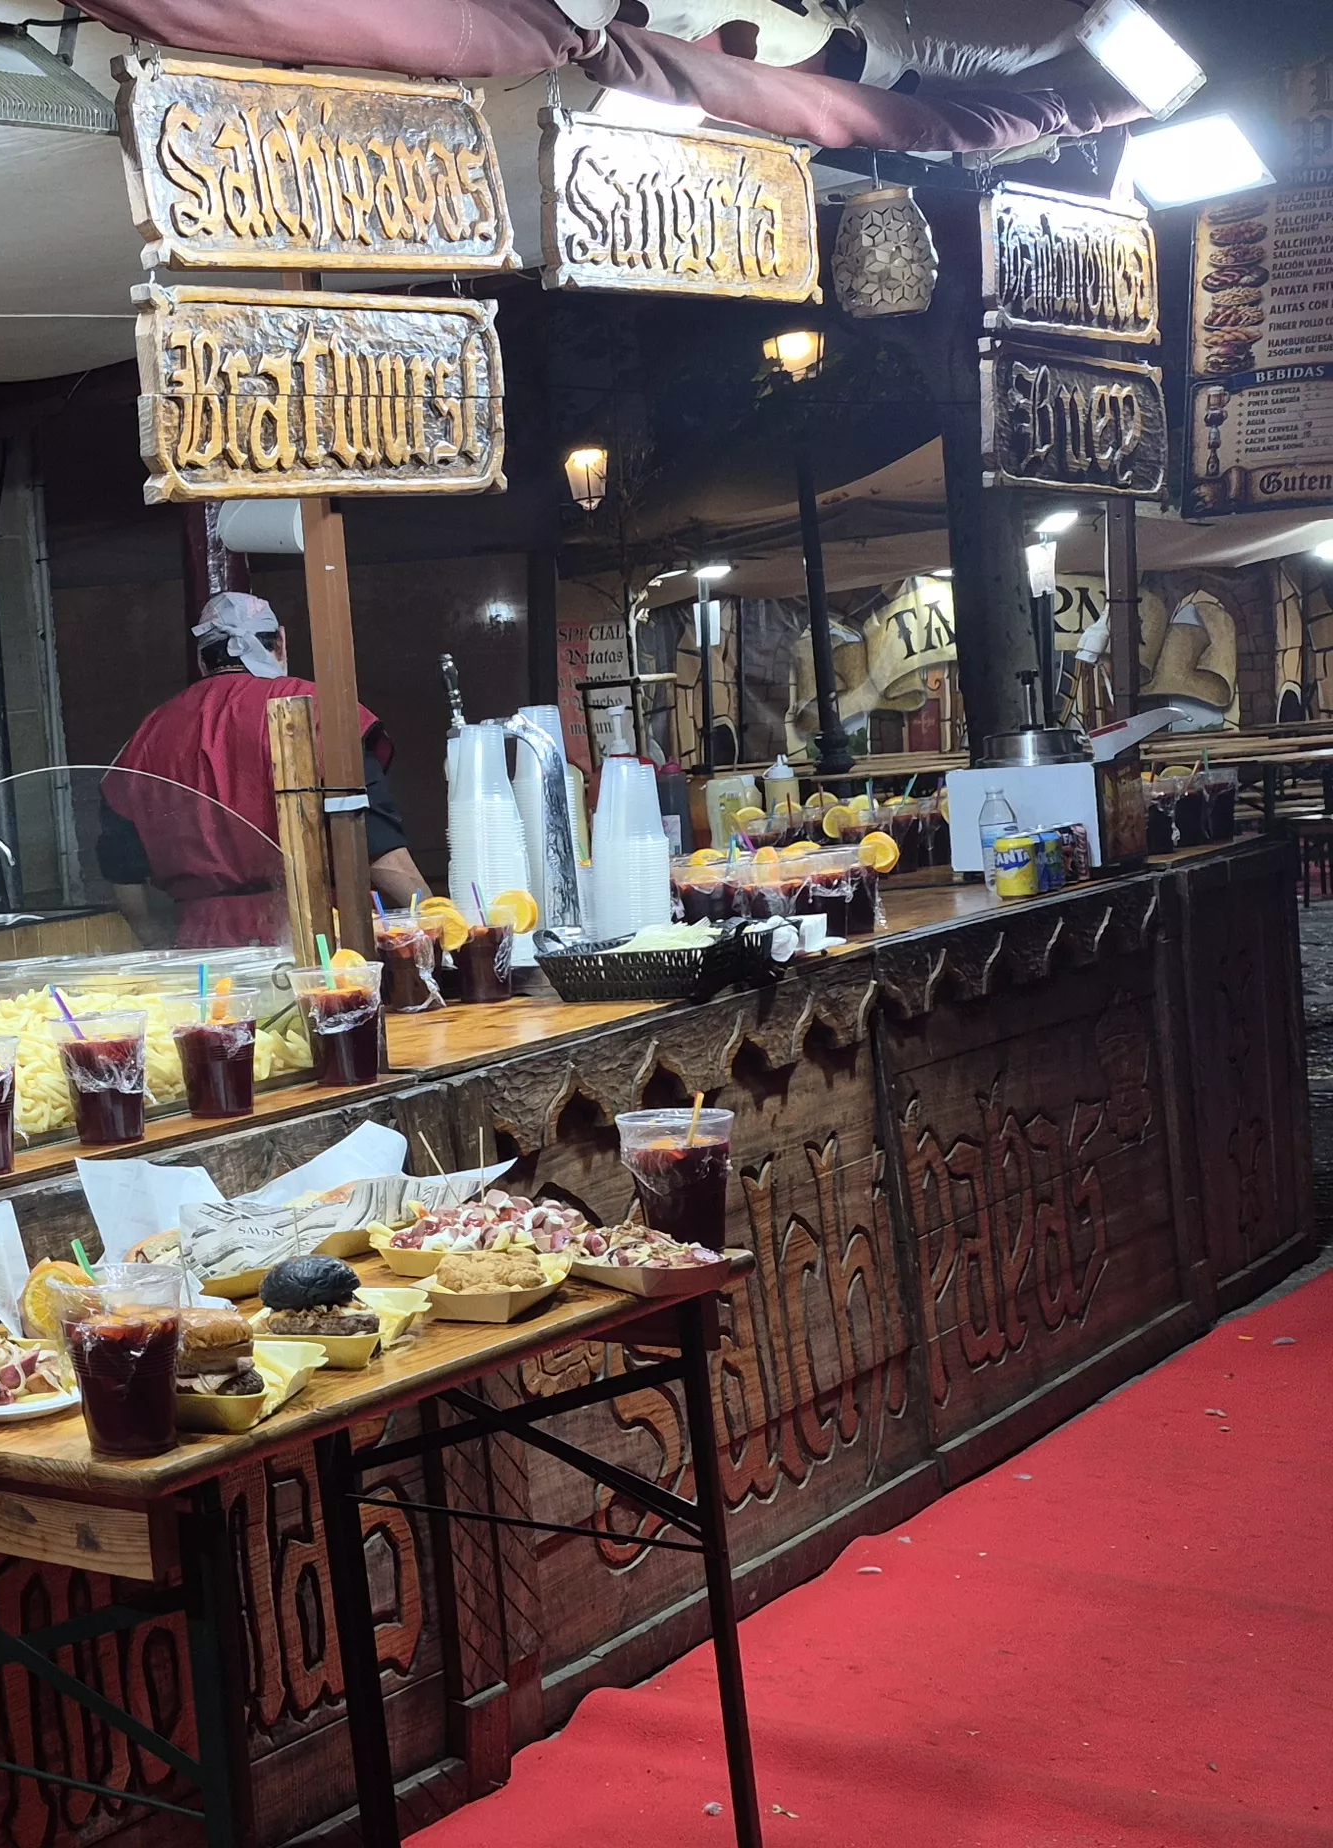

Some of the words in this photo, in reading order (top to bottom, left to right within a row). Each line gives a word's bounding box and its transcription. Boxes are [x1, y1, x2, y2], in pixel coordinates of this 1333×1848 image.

[160, 102, 495, 248] Salchipapas
[1270, 284, 1308, 297] PATATA
[1269, 302, 1305, 315] ALITAS
[1308, 300, 1328, 311] CON
[1268, 321, 1297, 332] FINGER
[1299, 318, 1324, 328] POLLO
[1305, 345, 1315, 354] DE
[1255, 365, 1325, 383] BEBIDAS
[166, 321, 485, 471] Bratwurst
[1247, 407, 1287, 417] REFRESCOS
[1259, 471, 1332, 495] Guten
